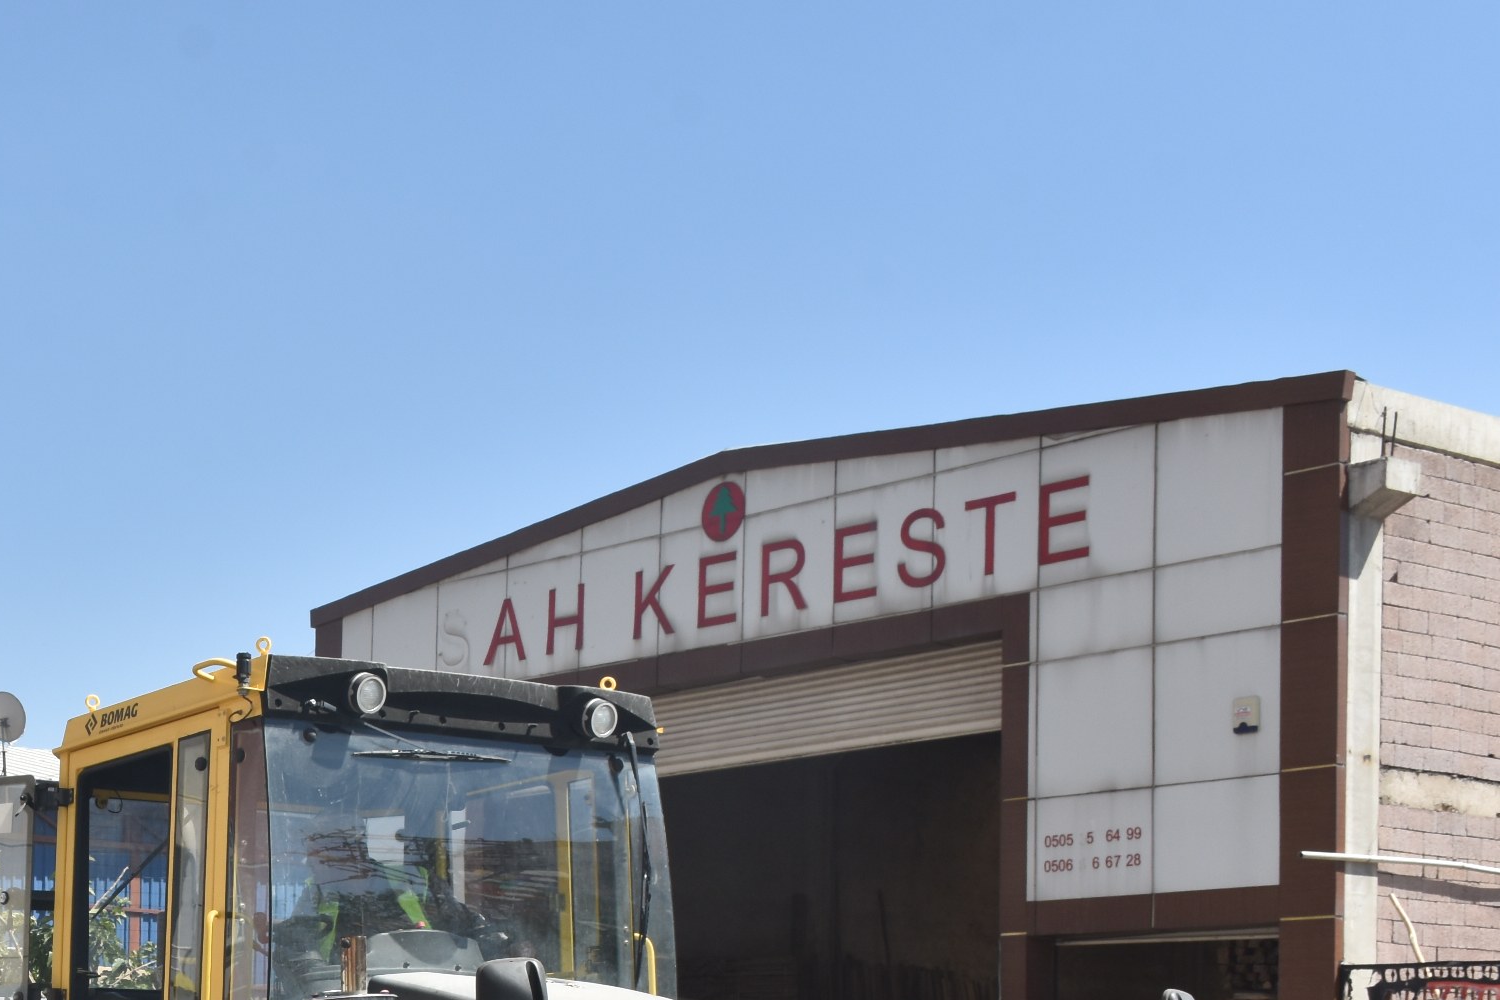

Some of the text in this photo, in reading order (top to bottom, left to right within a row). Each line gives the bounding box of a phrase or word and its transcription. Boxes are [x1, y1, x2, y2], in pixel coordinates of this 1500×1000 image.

[632, 475, 1090, 640] KERESTE
[100, 702, 139, 727] BOMAG
[1044, 833, 1074, 848] 0505
[1105, 829, 1121, 842] 64
[1126, 826, 1142, 841] 99
[1044, 858, 1073, 873] 0506
[1105, 854, 1121, 868] 67
[1126, 853, 1141, 867] 28
